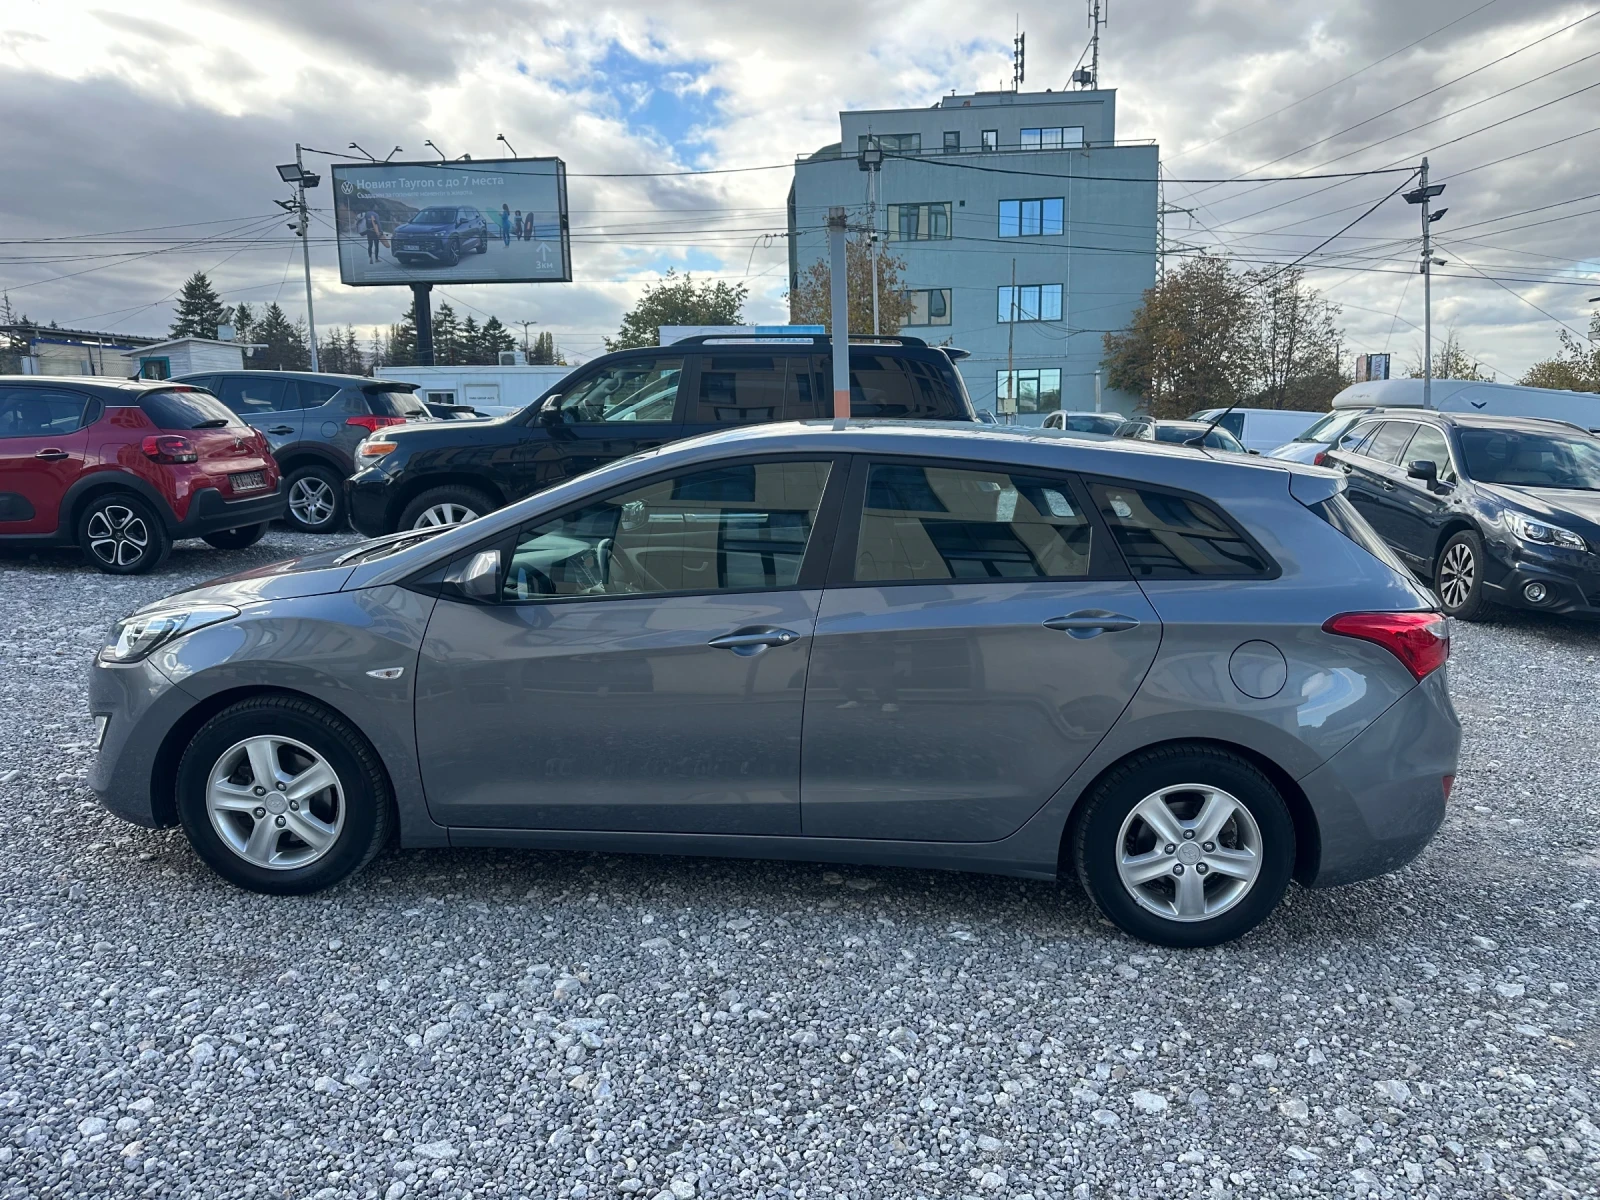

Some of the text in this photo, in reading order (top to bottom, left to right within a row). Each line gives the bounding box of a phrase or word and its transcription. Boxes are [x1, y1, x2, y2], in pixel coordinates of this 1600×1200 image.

[356, 179, 396, 190] Новият
[398, 177, 435, 190] Tayron
[445, 178, 460, 188] до
[462, 175, 469, 186] 7
[471, 176, 505, 186] места
[535, 260, 553, 269] 3км
